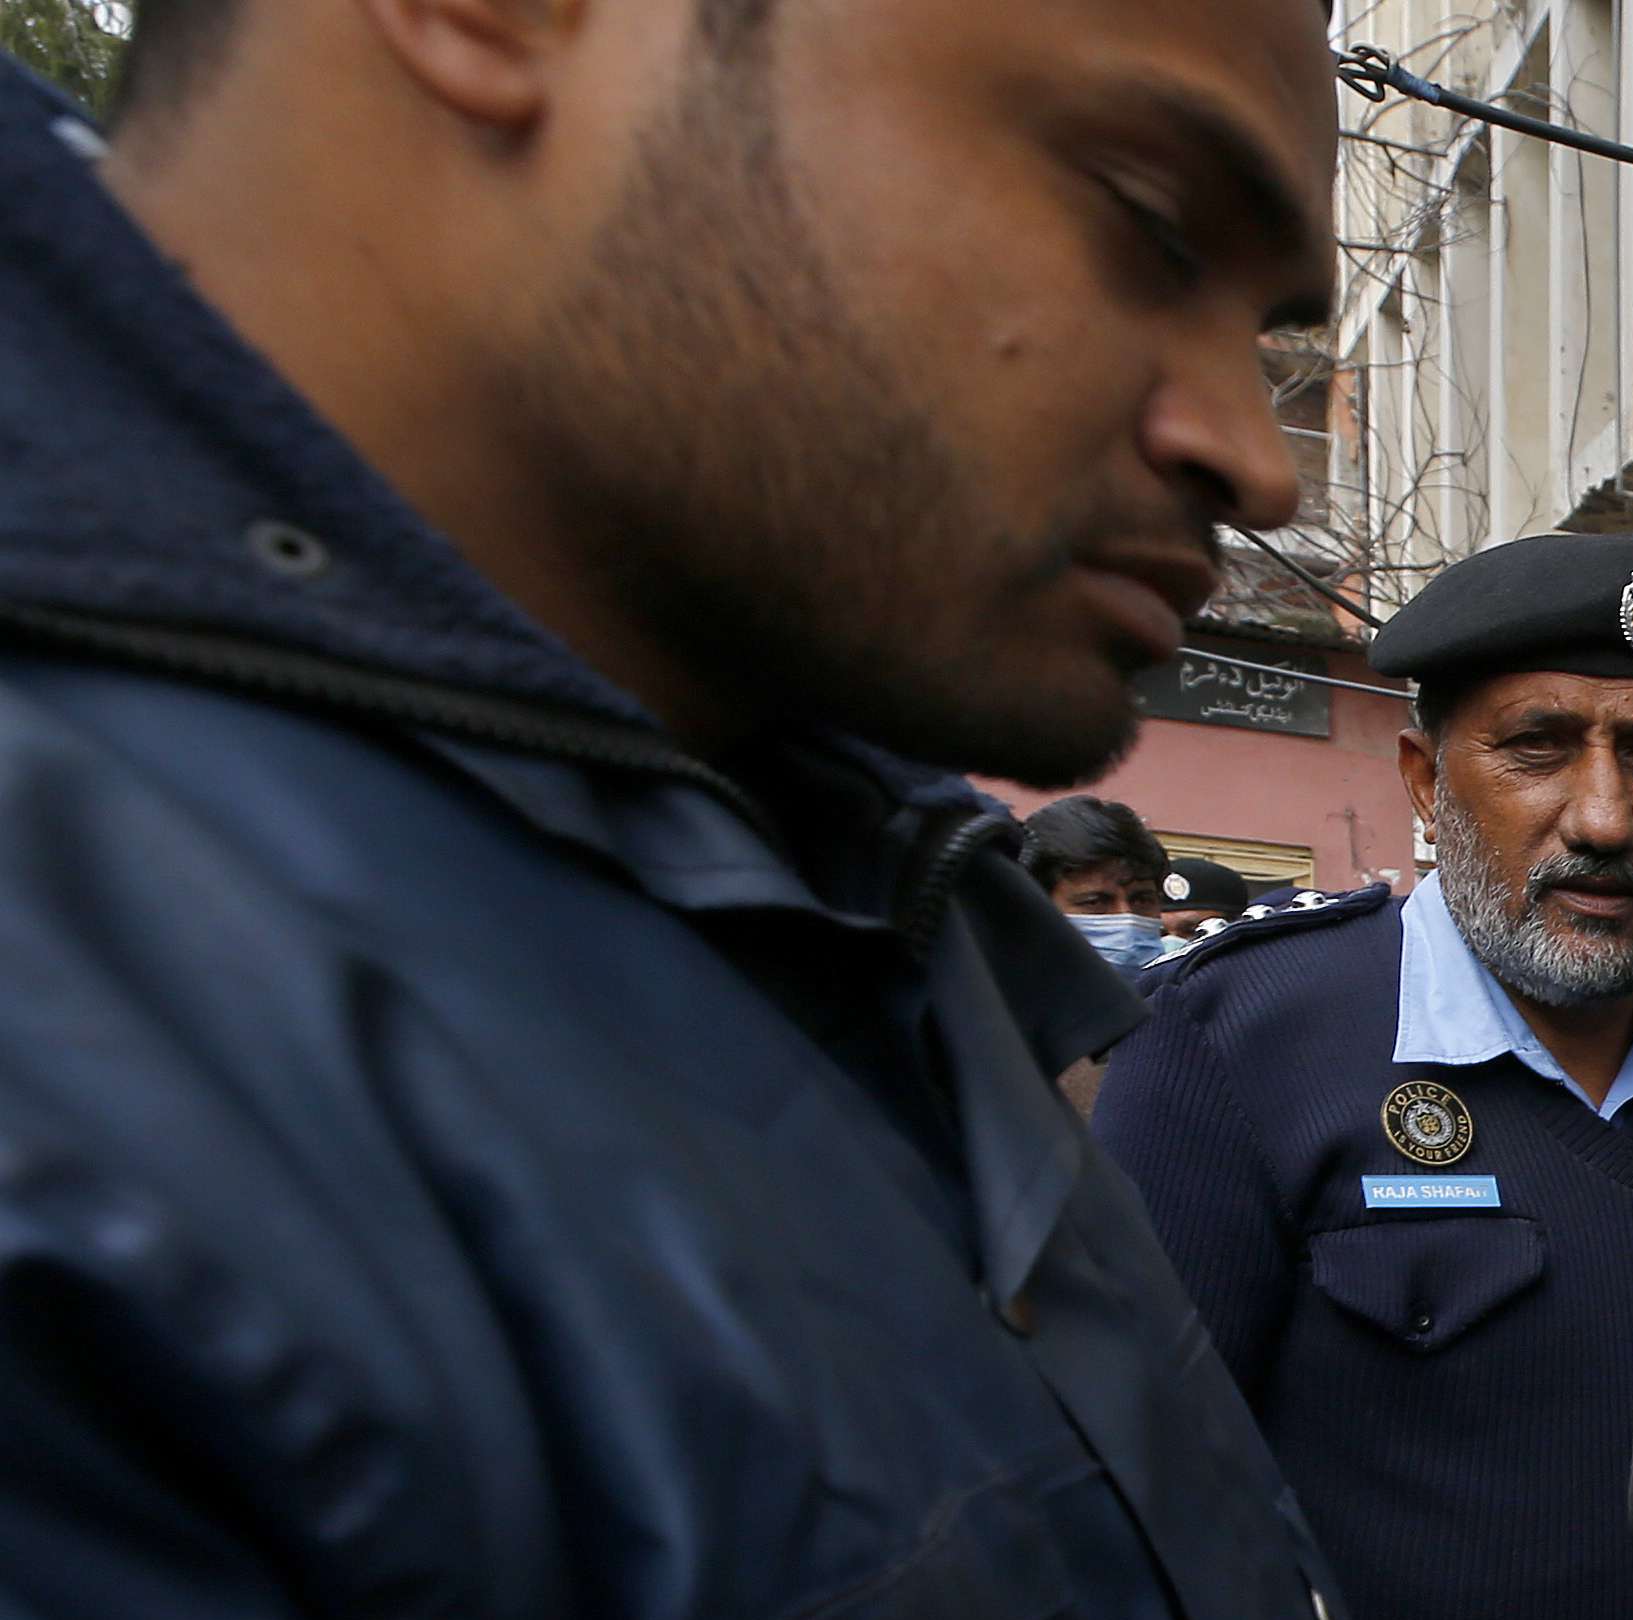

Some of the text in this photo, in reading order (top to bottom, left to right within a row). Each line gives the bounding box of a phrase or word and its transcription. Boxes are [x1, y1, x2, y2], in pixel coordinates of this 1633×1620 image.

[1388, 1084, 1452, 1115] POLICE
[1445, 1114, 1469, 1158] FRIEND
[1407, 1143, 1443, 1161] YOUR
[1372, 1185, 1419, 1200] RAJA
